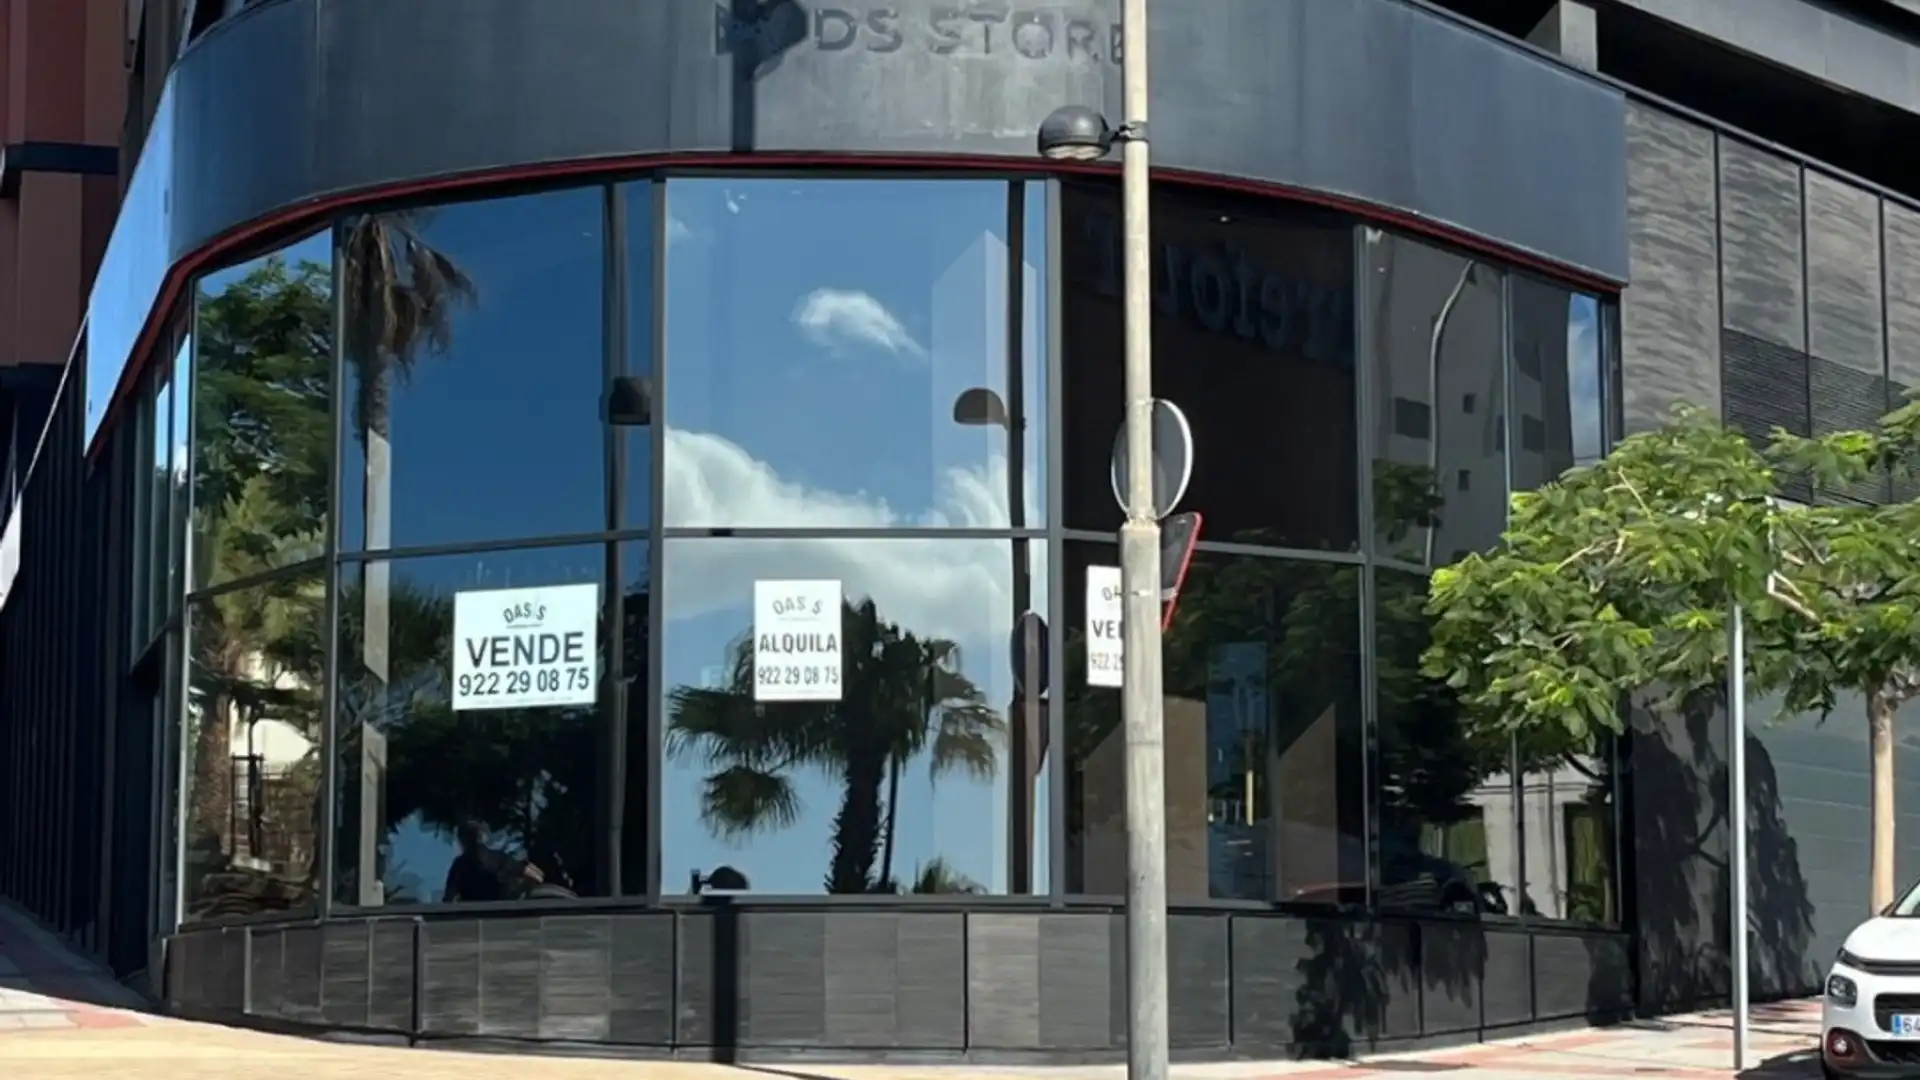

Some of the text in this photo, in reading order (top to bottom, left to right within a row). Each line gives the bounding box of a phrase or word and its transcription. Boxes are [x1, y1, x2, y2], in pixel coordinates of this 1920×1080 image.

[503, 602, 547, 624] OASS
[772, 596, 823, 615] OASS
[1091, 620, 1124, 640] VE
[466, 631, 584, 669] VENDE
[759, 632, 838, 656] ALQUILA
[458, 667, 590, 696] 922 29 08 75
[758, 666, 838, 686] 922 29 08 75
